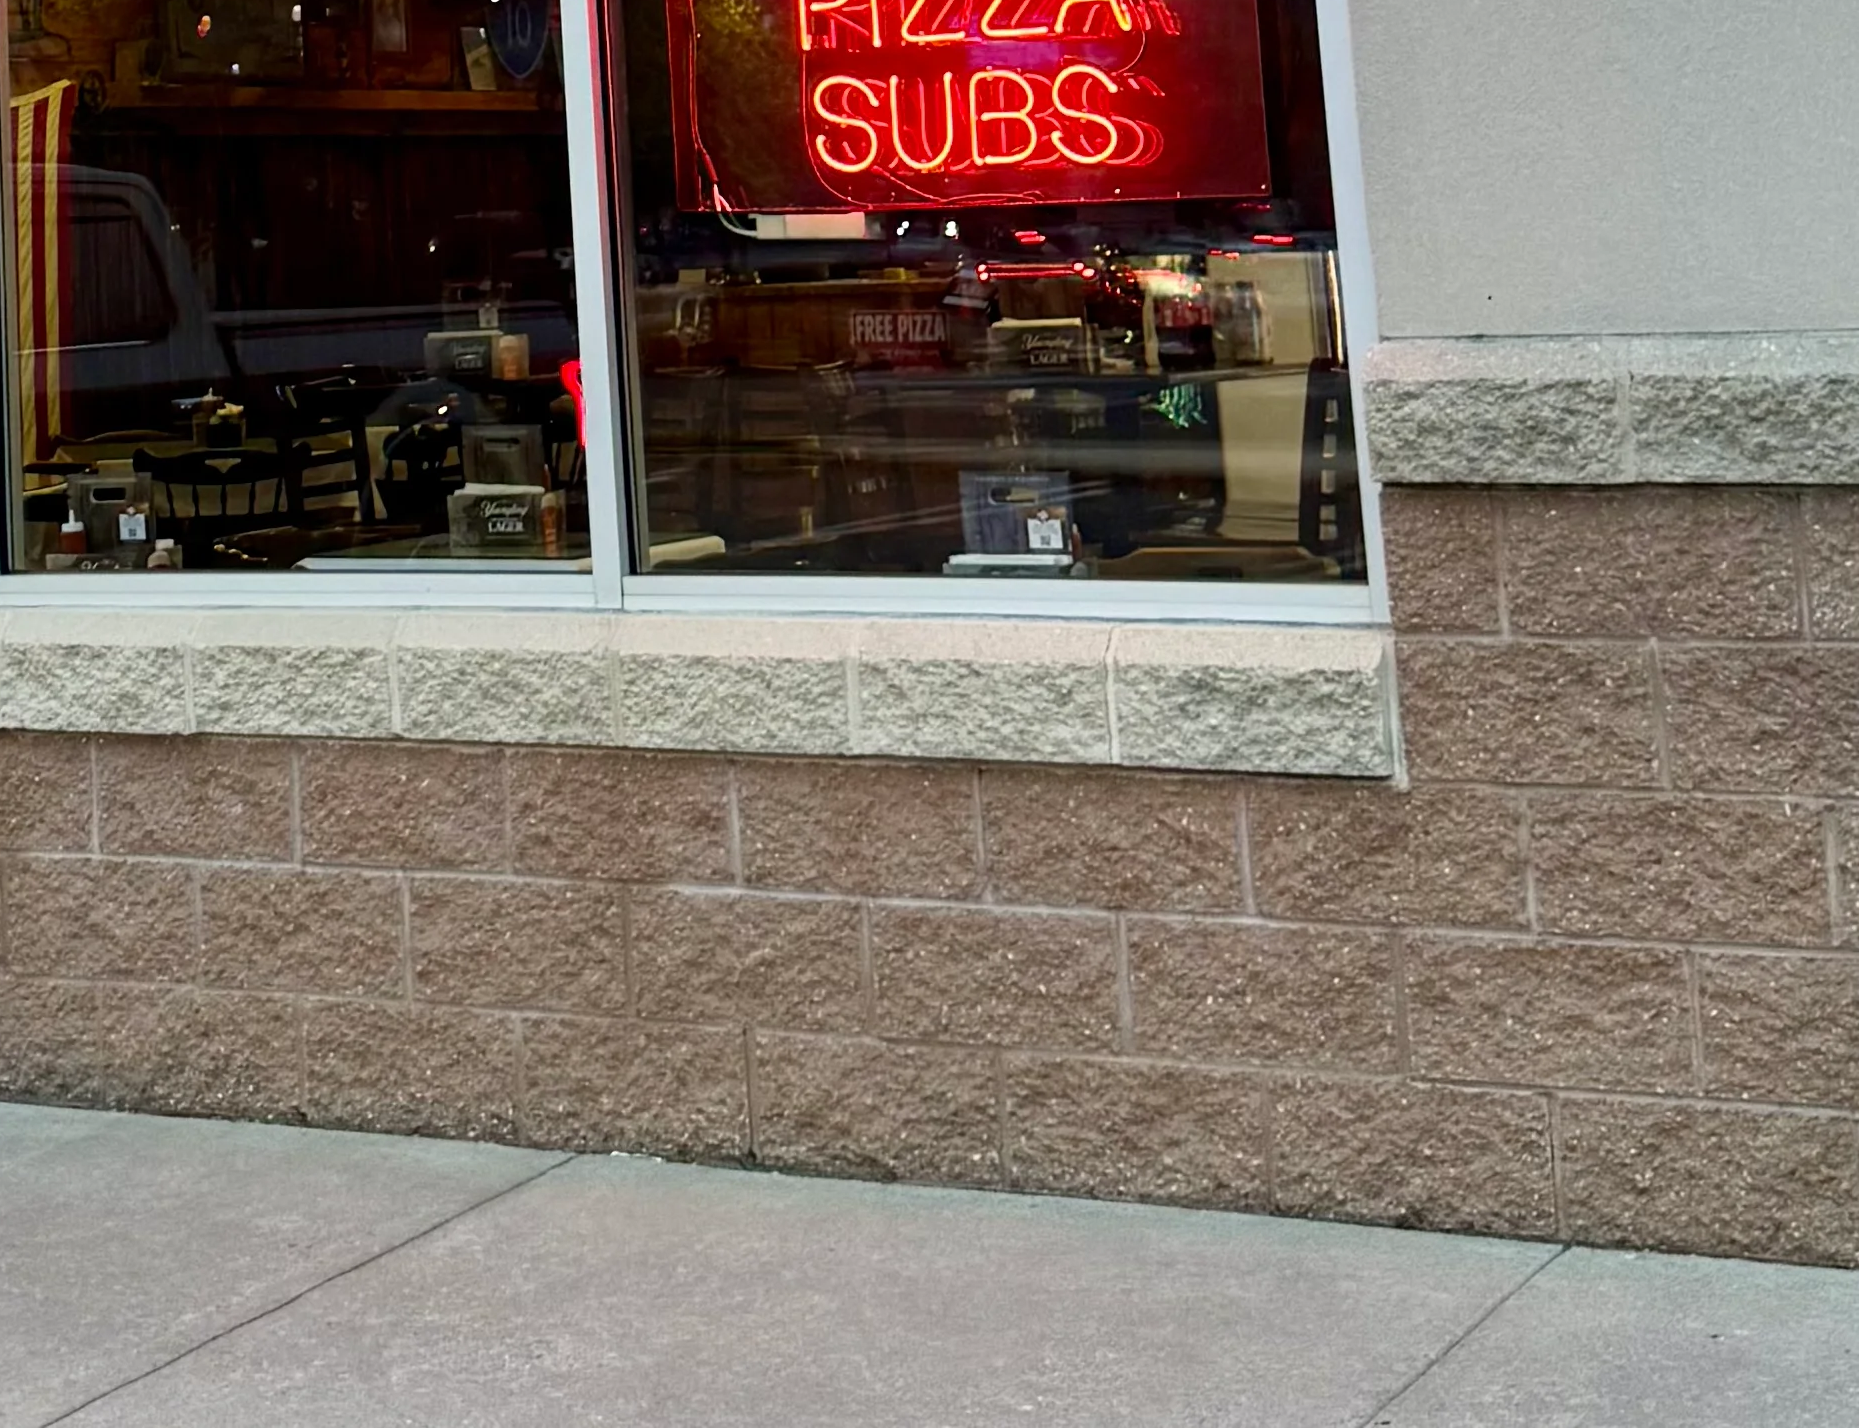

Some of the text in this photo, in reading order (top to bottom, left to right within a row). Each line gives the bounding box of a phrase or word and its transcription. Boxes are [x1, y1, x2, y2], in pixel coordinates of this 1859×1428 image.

[813, 64, 1118, 173] SUBS
[854, 312, 946, 343] FREE PIZZA
